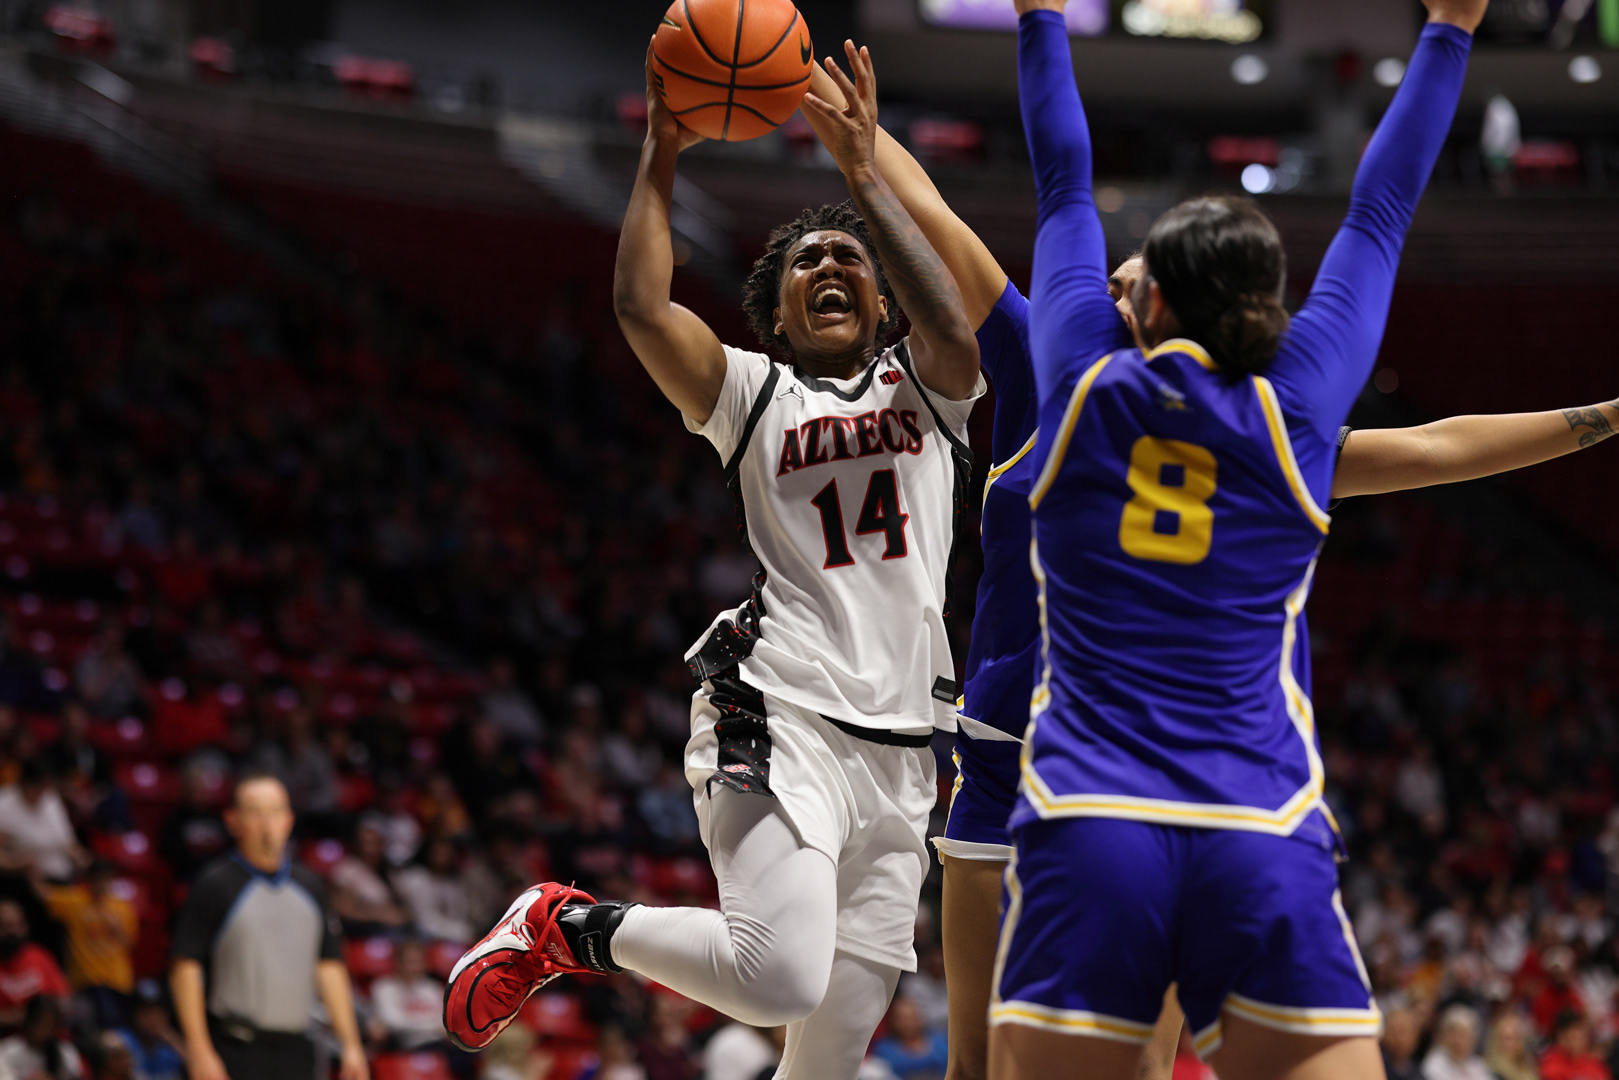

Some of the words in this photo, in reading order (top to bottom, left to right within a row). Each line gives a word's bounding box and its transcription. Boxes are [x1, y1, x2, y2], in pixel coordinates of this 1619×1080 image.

[776, 408, 924, 477] AZTECS
[810, 469, 909, 569] 14
[1118, 435, 1218, 565] 8
